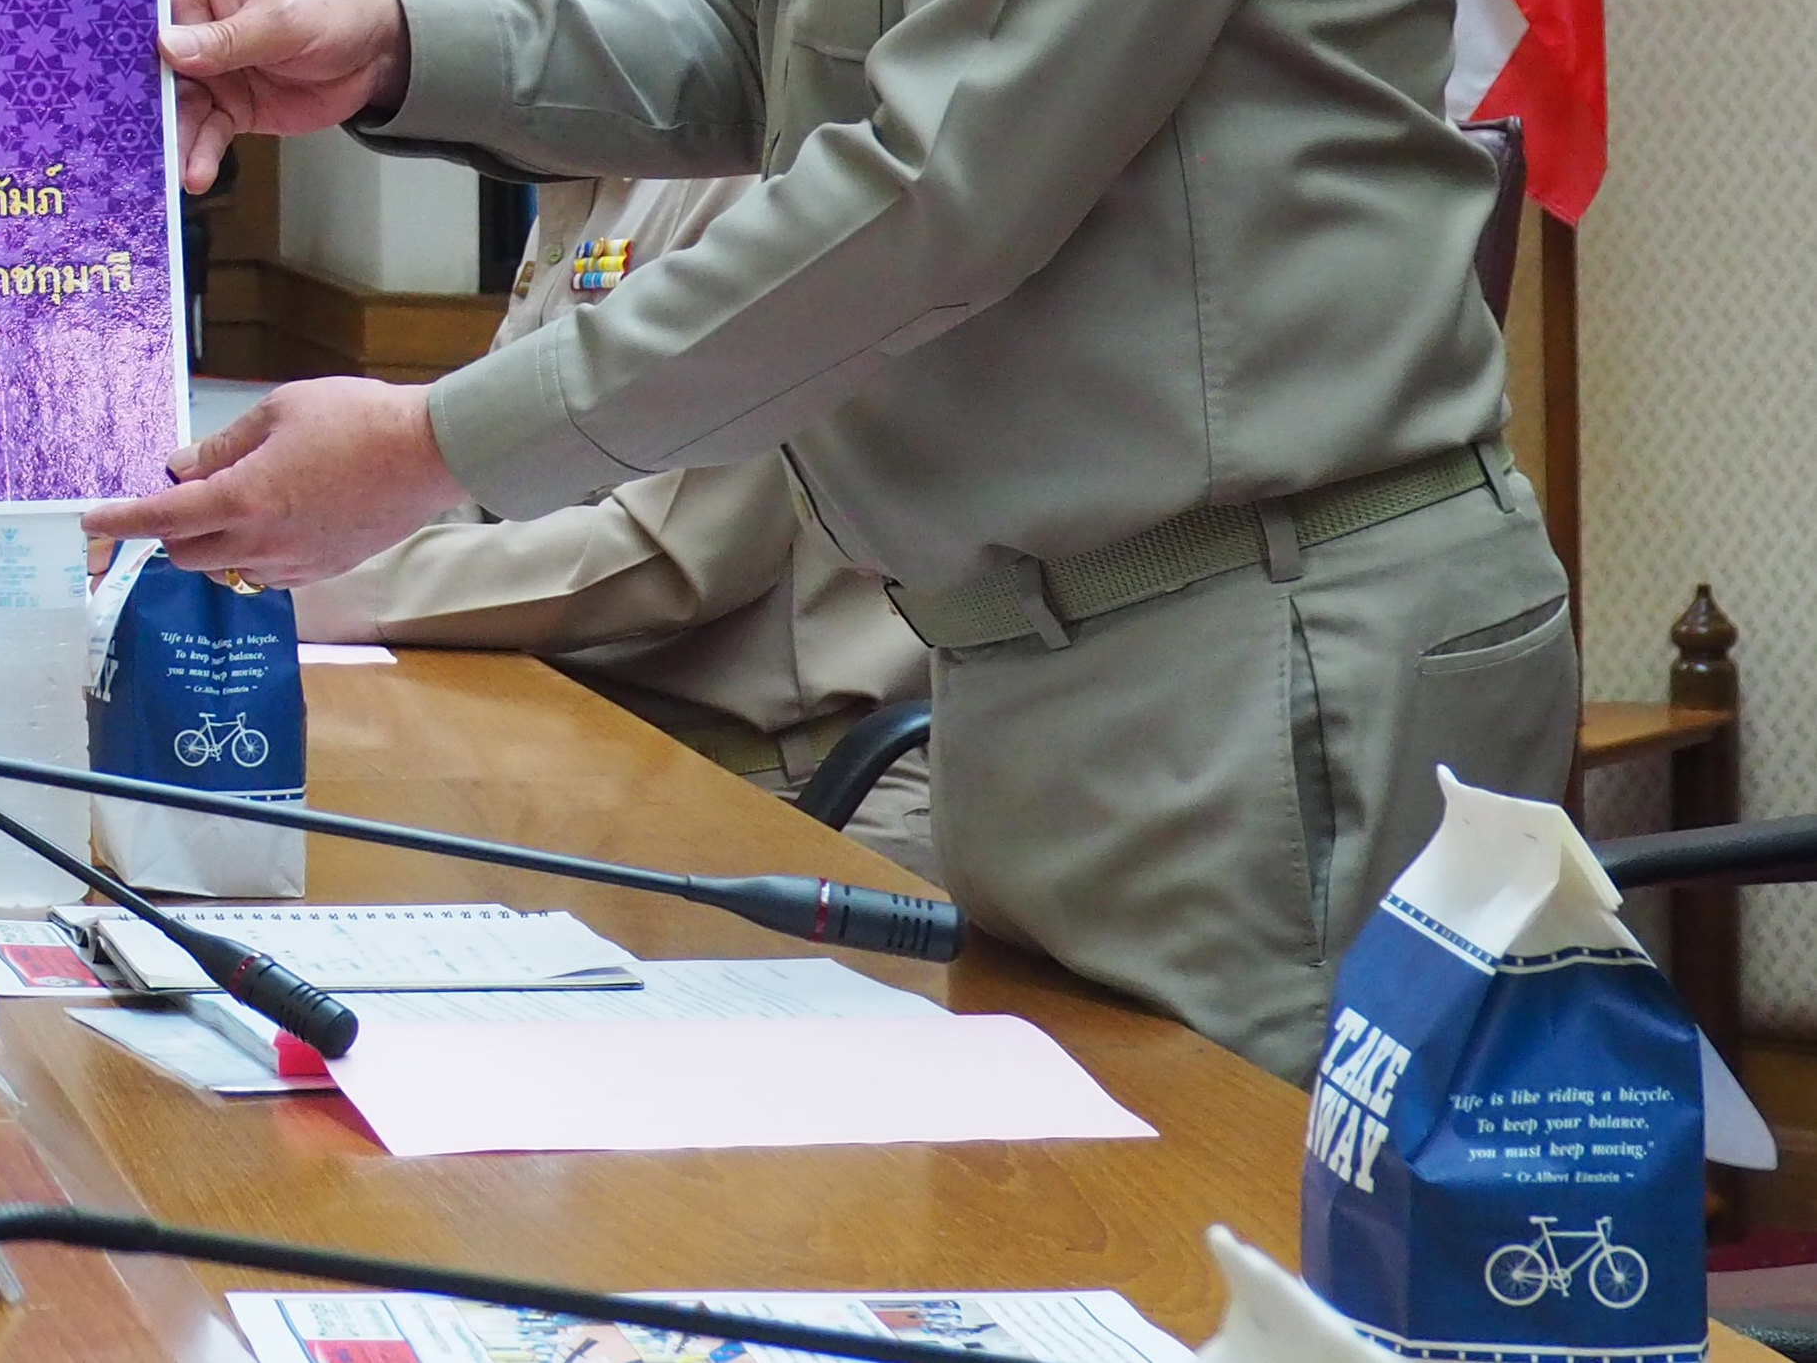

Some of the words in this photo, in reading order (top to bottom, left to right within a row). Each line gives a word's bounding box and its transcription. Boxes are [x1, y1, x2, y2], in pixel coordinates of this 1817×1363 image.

[185, 634, 194, 643] is
[236, 637, 243, 645] a
[175, 649, 186, 658] To
[1320, 1007, 1412, 1118] TAKE
[1490, 1093, 1504, 1106] is
[1511, 1090, 1540, 1105] like
[1548, 1087, 1595, 1106] riding
[1602, 1091, 1611, 1102] a
[1619, 1086, 1674, 1106] bicycle.
[1477, 1118, 1495, 1133] To
[1503, 1117, 1538, 1135] keep
[1545, 1117, 1582, 1134] your
[1468, 1148, 1497, 1162] you
[1505, 1145, 1541, 1158] must
[1550, 1141, 1584, 1160] keep
[1575, 1171, 1620, 1183] Einstein
